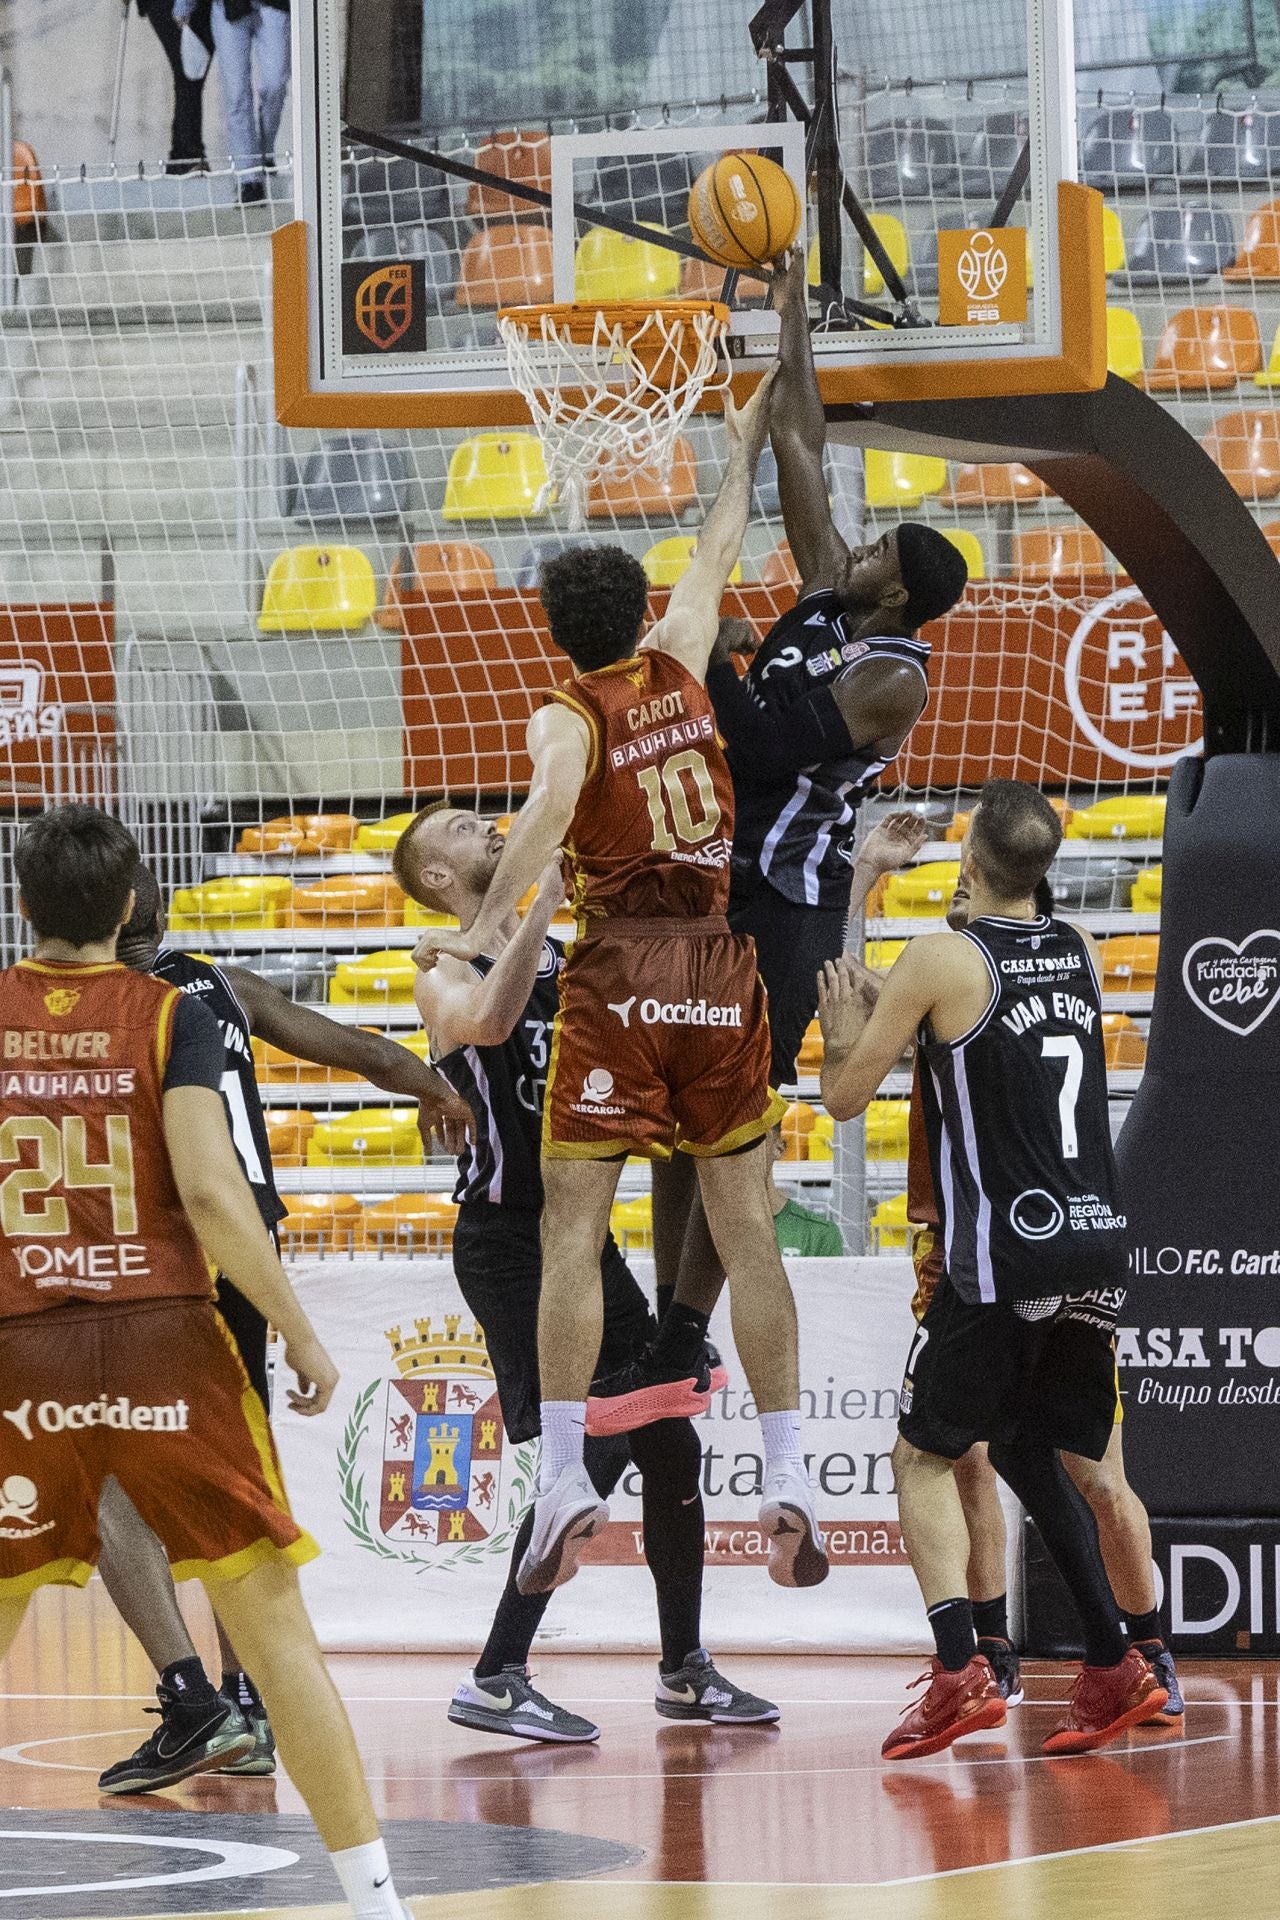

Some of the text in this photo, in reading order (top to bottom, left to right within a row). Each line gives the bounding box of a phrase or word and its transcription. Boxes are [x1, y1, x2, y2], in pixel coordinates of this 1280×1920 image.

[389, 270, 407, 278] FEB
[967, 310, 1000, 321] FEB
[627, 690, 685, 731] CAROT
[1110, 682, 1200, 720] EF
[612, 718, 715, 768] BAUHAUS
[636, 749, 722, 851] 10
[1001, 952, 1081, 973] CASA TOMÁS
[640, 998, 742, 1027] Occident
[1001, 992, 1097, 1036] VAN EYCK
[1041, 1035, 1084, 1158] 7
[0, 1115, 138, 1237] 24
[1069, 1203, 1112, 1218] REGIÓN
[1070, 1219, 1090, 1231] DE
[1128, 1246, 1280, 1275] ILO F.C. Cart
[37, 1393, 190, 1431] Occident
[1138, 1377, 1212, 1412] Grupo
